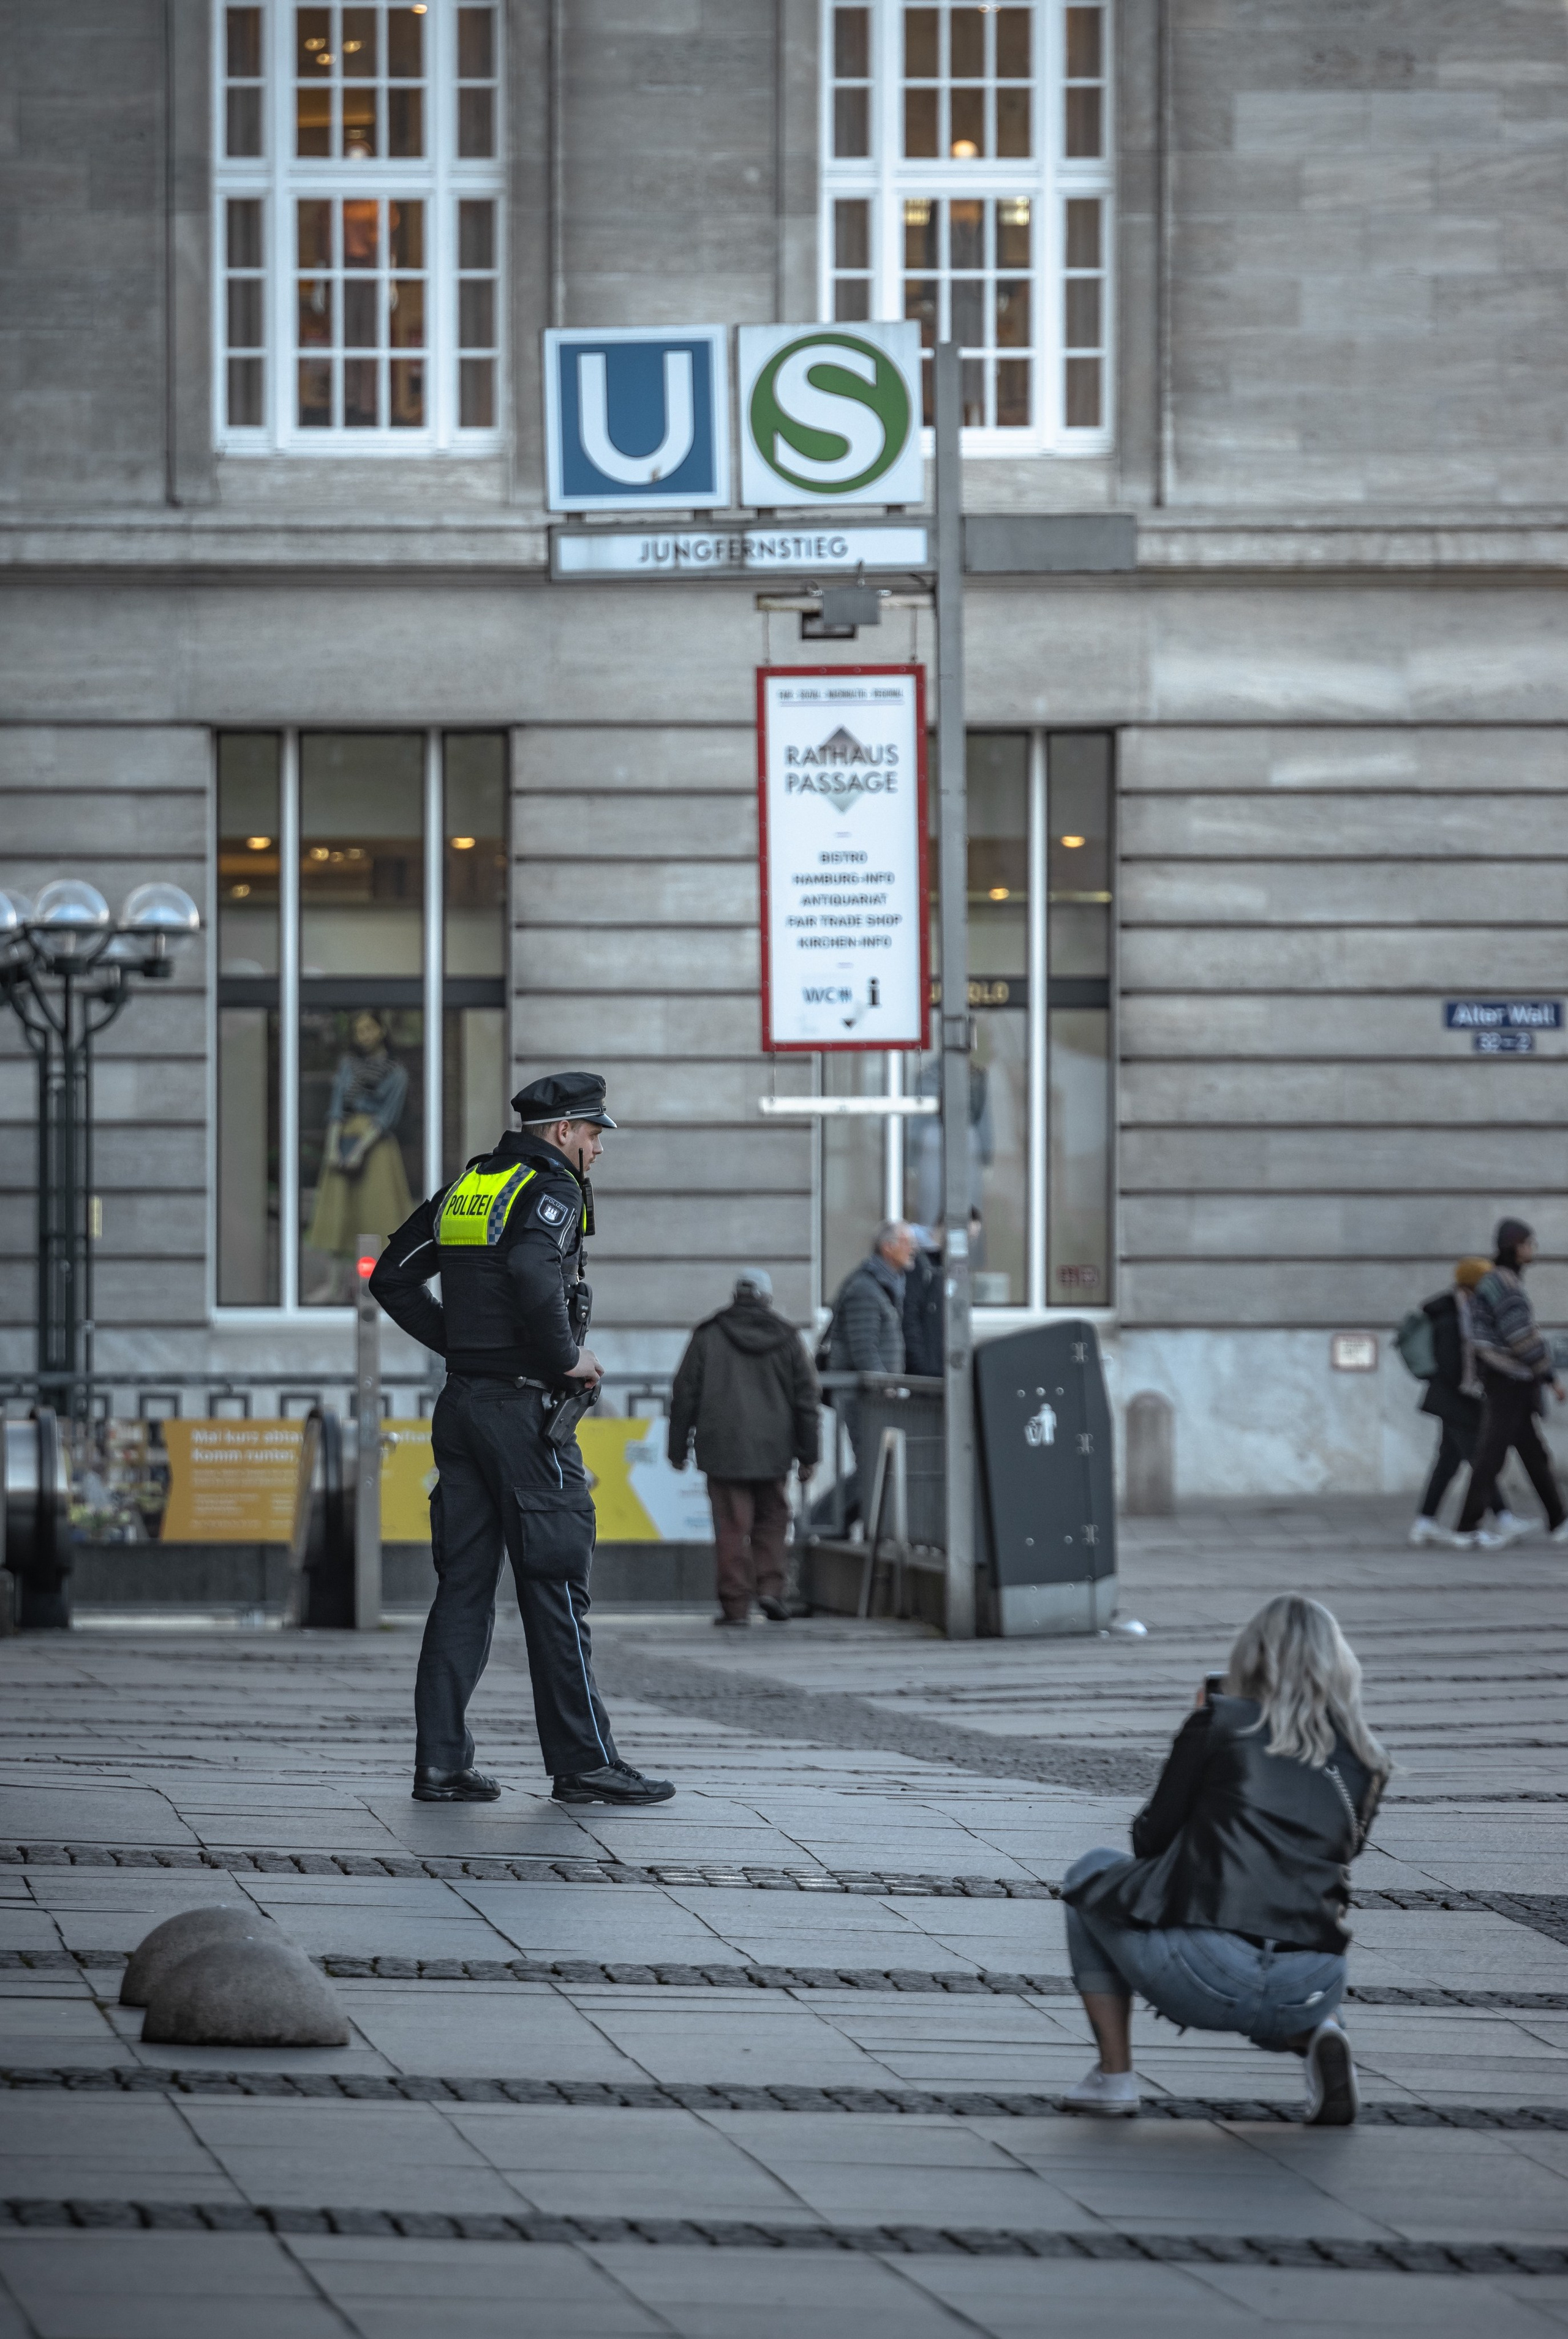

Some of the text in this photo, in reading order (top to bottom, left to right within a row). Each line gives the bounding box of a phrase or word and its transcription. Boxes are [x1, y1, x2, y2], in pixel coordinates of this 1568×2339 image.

[578, 343, 886, 484] U S
[638, 537, 849, 563] JUNGFERNSTIEG
[785, 744, 899, 767] RATHAUS
[785, 771, 899, 794] PASSAGE
[819, 851, 868, 864] BISTRO
[792, 872, 895, 886] HAMBURG-INFO
[800, 893, 888, 907] ANTIQUARIAT
[786, 914, 902, 927] FAIR TRADE SHOP
[797, 935, 892, 949] KIRCHEN-INFO
[802, 987, 837, 1004] WC
[1451, 1003, 1556, 1025] Alter Wall
[445, 1194, 492, 1216] POLIZEI
[545, 1197, 566, 1212] POLIZEI
